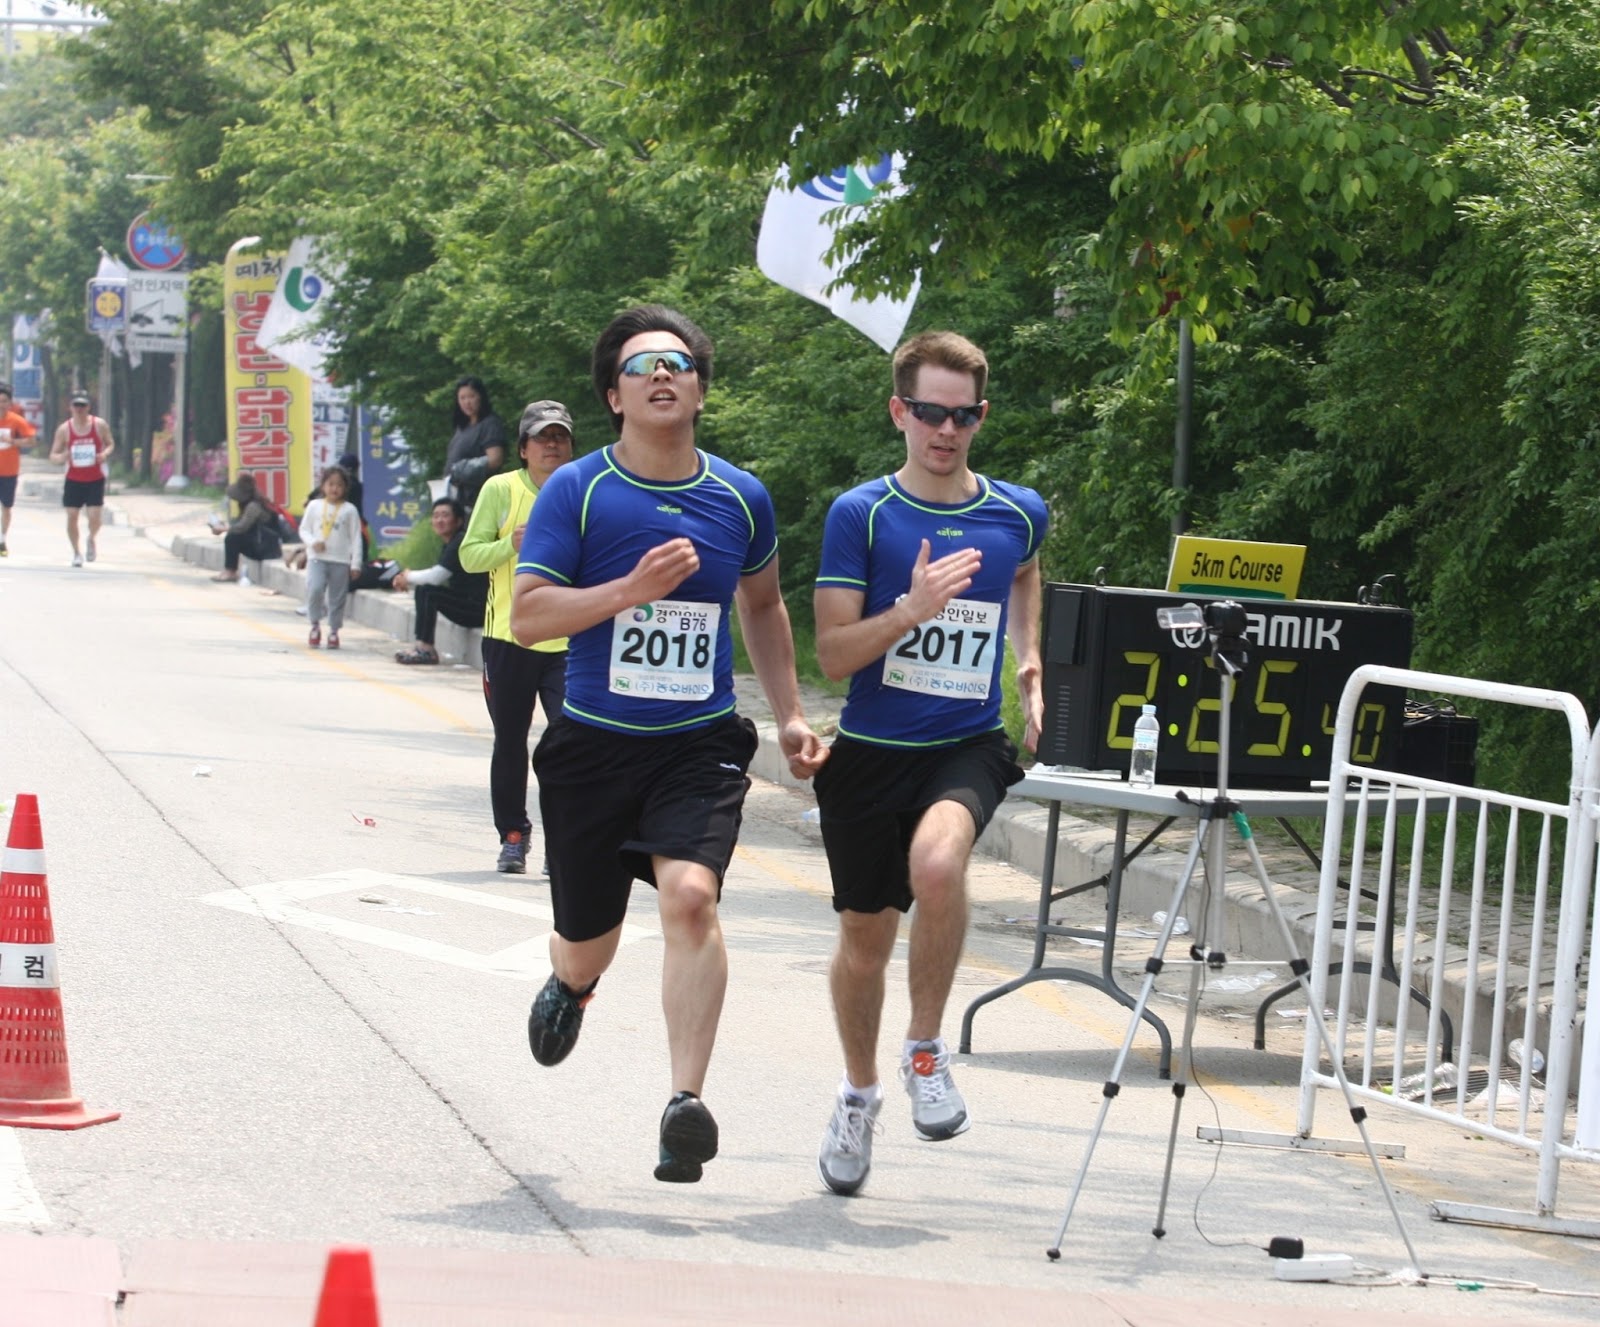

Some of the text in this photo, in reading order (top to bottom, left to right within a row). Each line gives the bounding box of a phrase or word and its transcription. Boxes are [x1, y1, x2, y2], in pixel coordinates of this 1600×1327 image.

[1191, 552, 1283, 582] 5km Course
[680, 617, 706, 632] B76
[1212, 612, 1343, 650] AMIK
[620, 627, 710, 669] 2018
[895, 624, 991, 667] 2017
